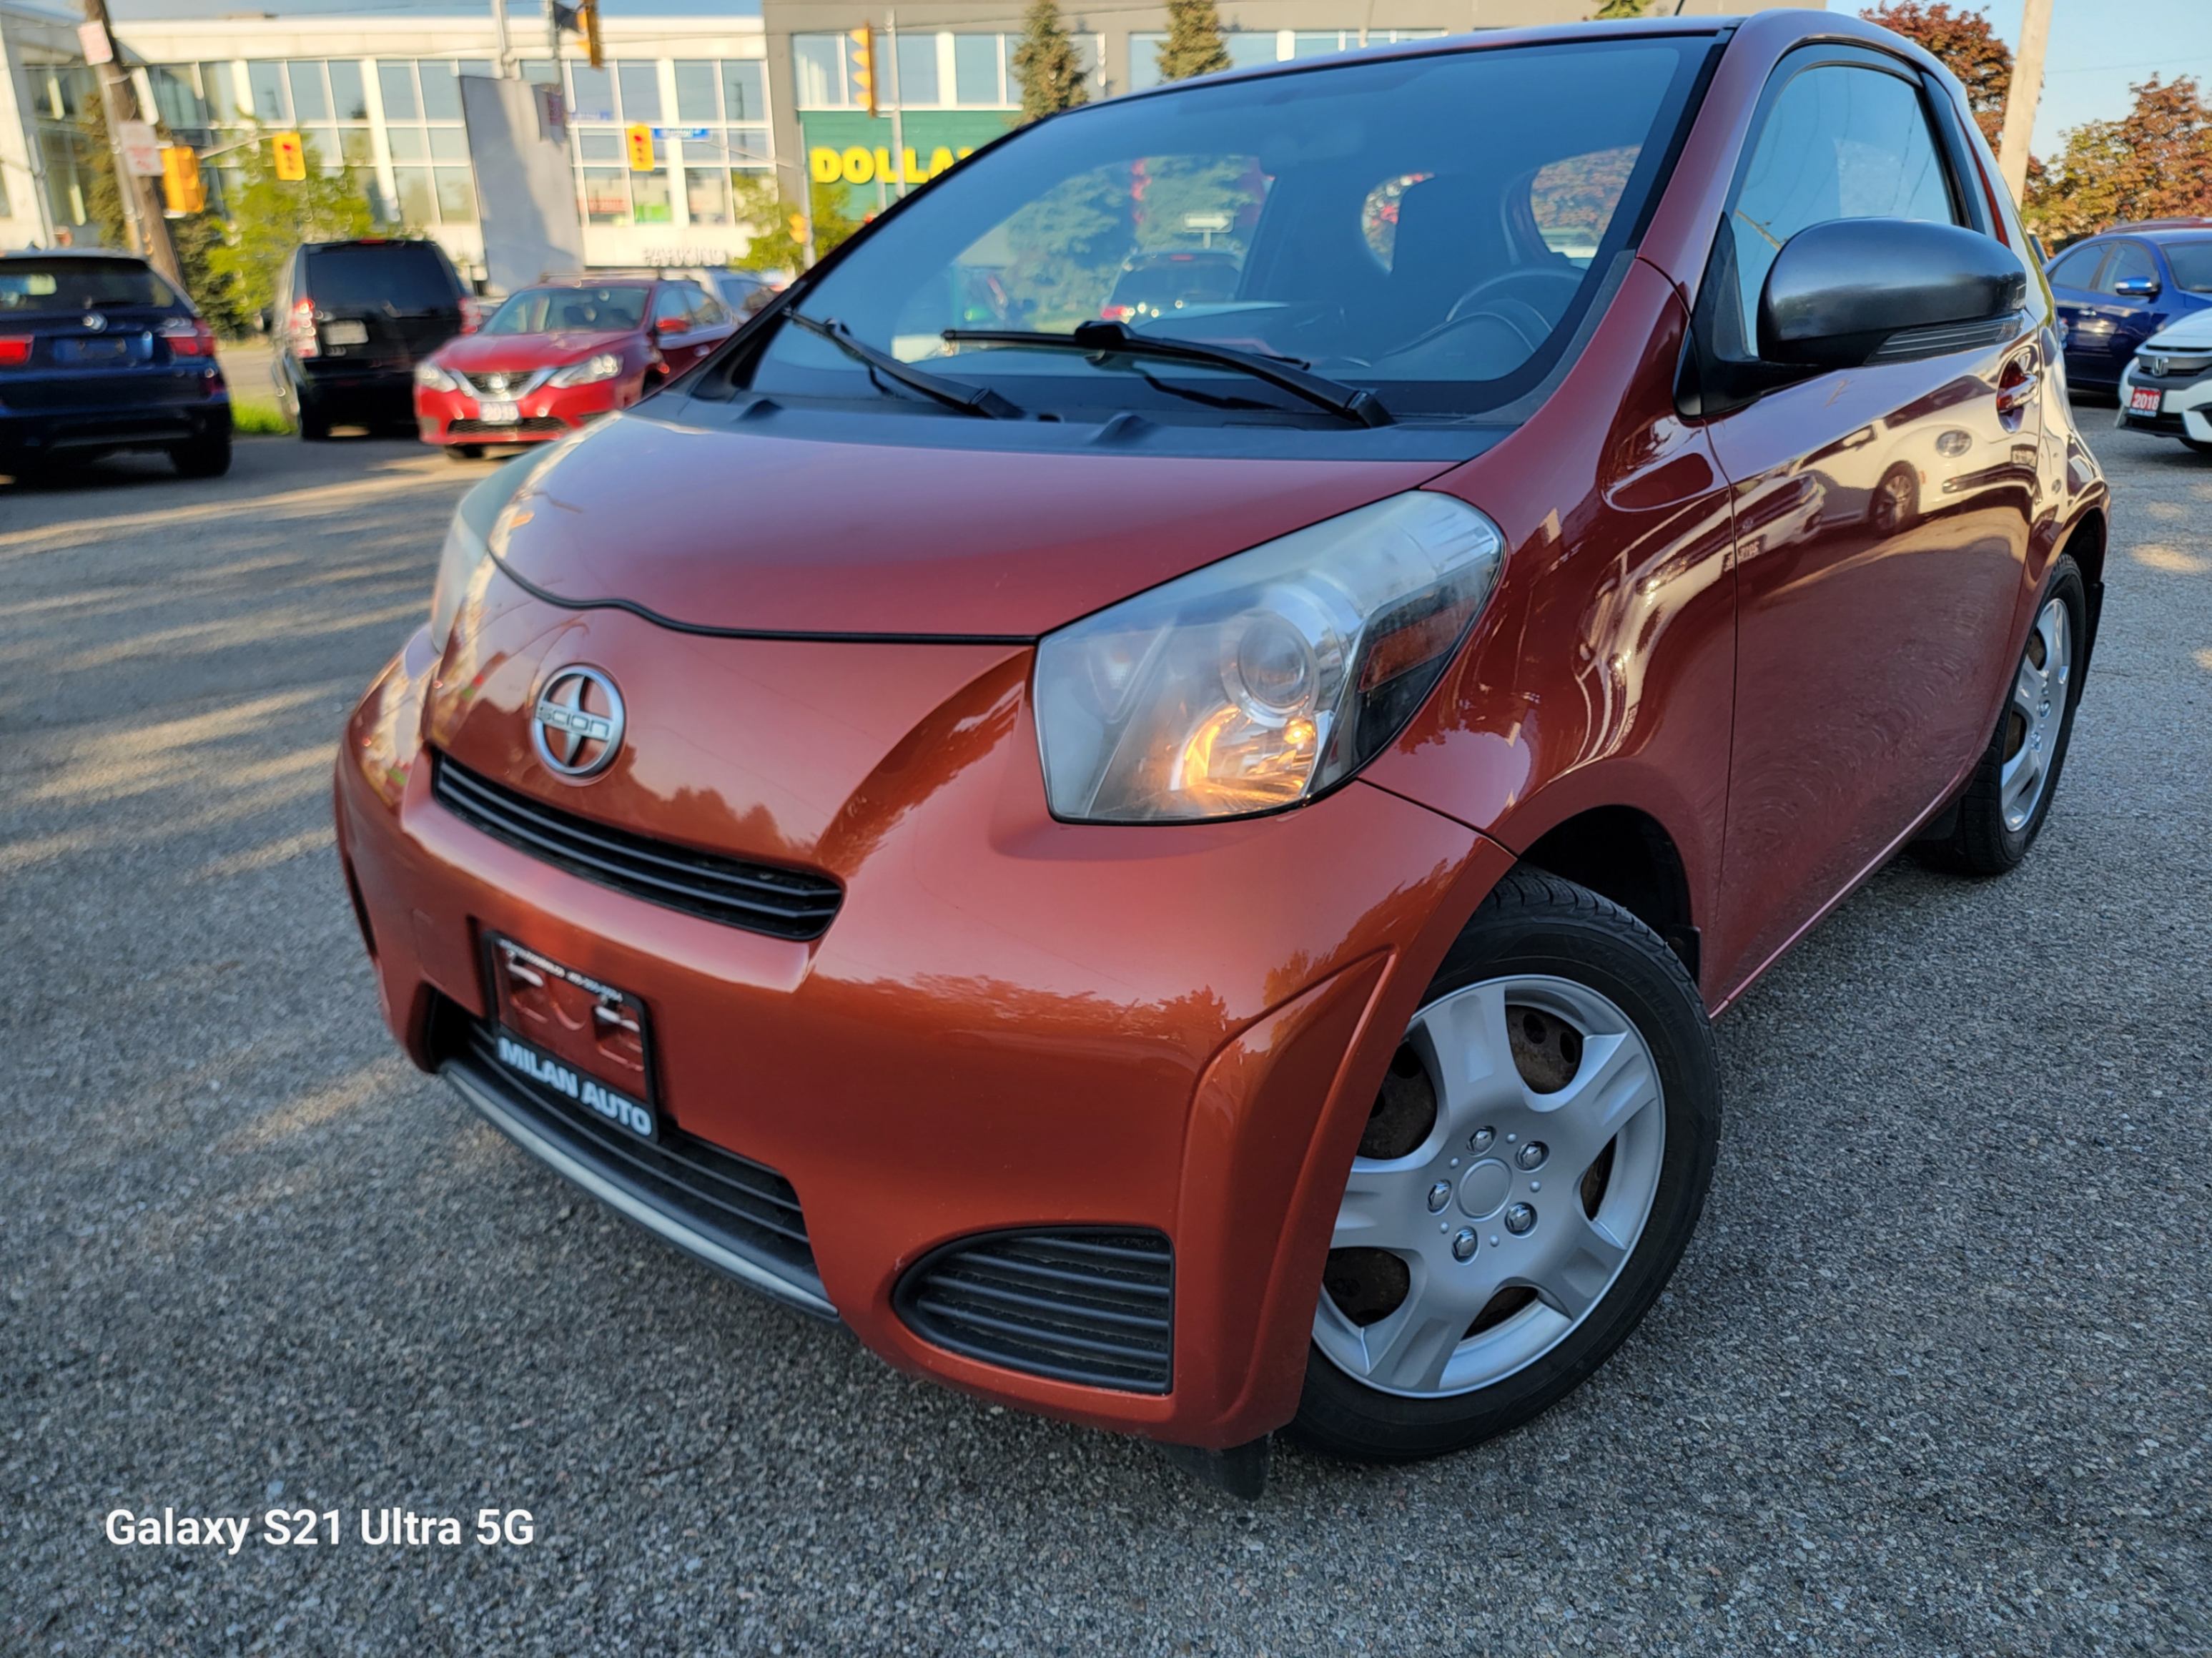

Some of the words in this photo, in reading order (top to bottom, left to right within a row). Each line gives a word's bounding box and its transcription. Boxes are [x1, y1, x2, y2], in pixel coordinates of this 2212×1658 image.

[809, 146, 975, 184] DOLLA
[2132, 393, 2160, 411] 2018
[498, 1037, 578, 1099] MILAN
[581, 1080, 653, 1136] AUTO
